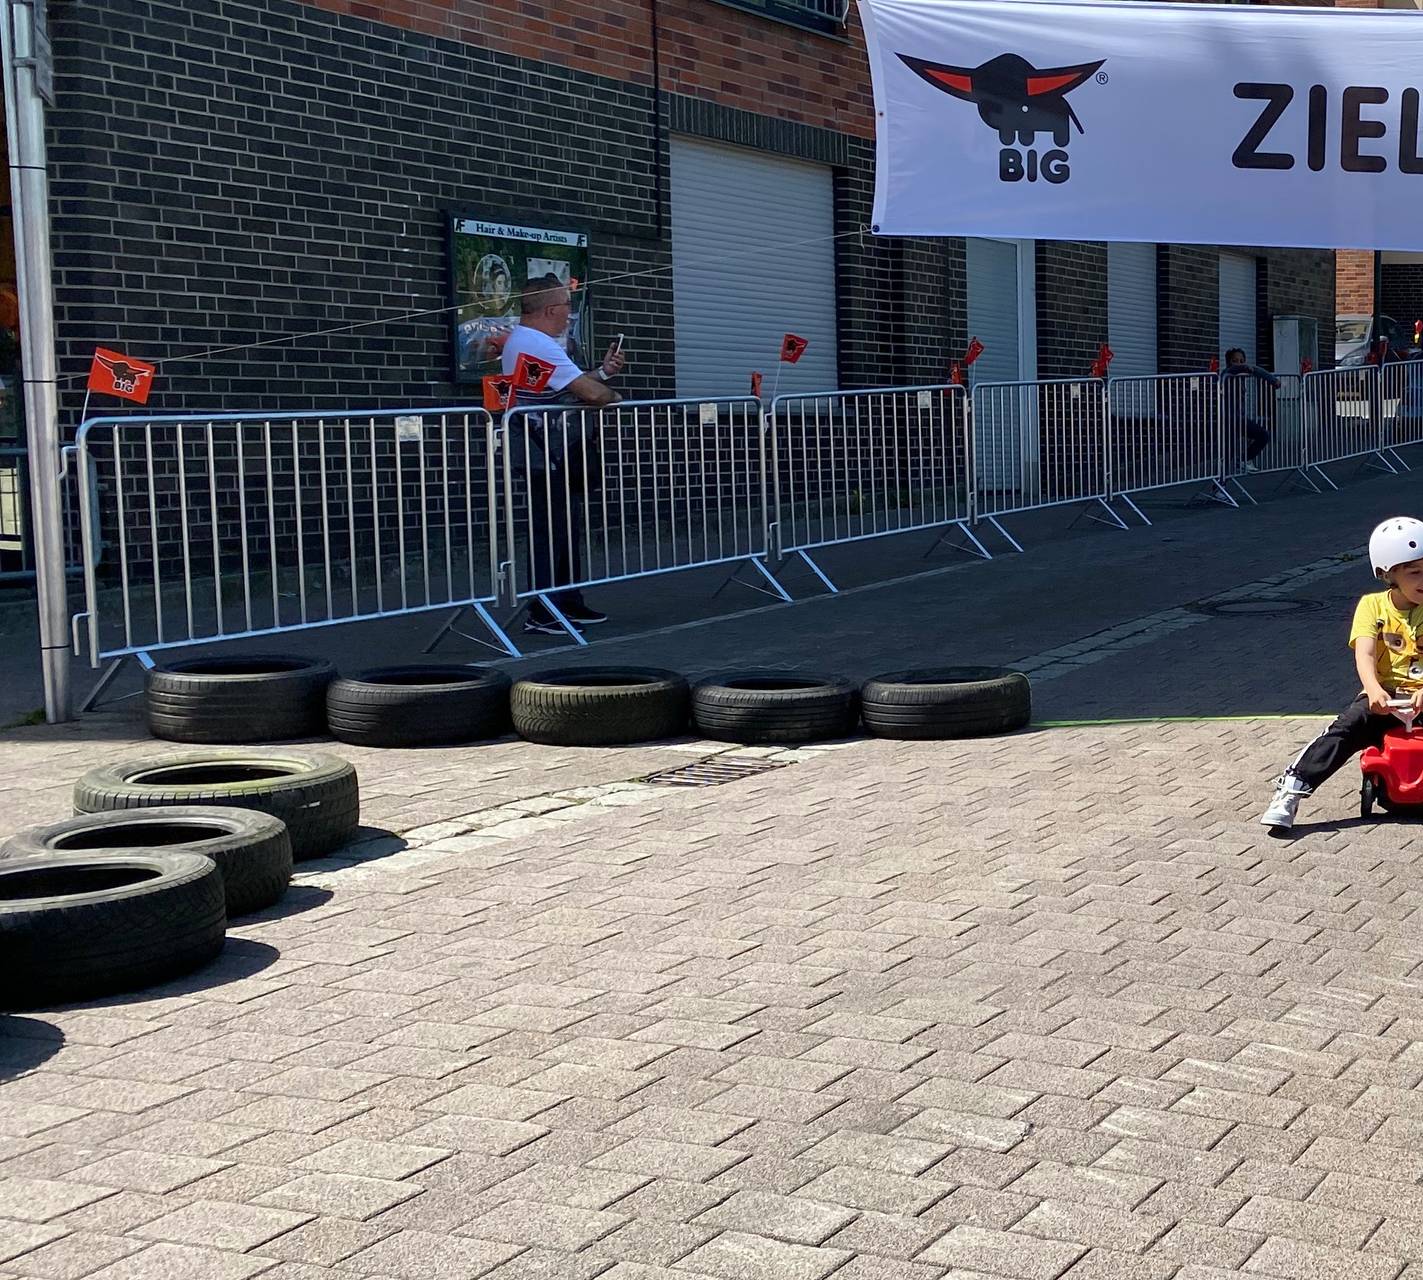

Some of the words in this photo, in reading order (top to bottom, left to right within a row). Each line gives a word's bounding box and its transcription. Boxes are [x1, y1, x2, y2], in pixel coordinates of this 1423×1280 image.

[999, 148, 1070, 184] BIG
[476, 223, 496, 234] Hair
[497, 227, 505, 236] &
[506, 227, 542, 241] Make-up
[543, 231, 568, 243] Artists
[113, 380, 134, 393] BIG
